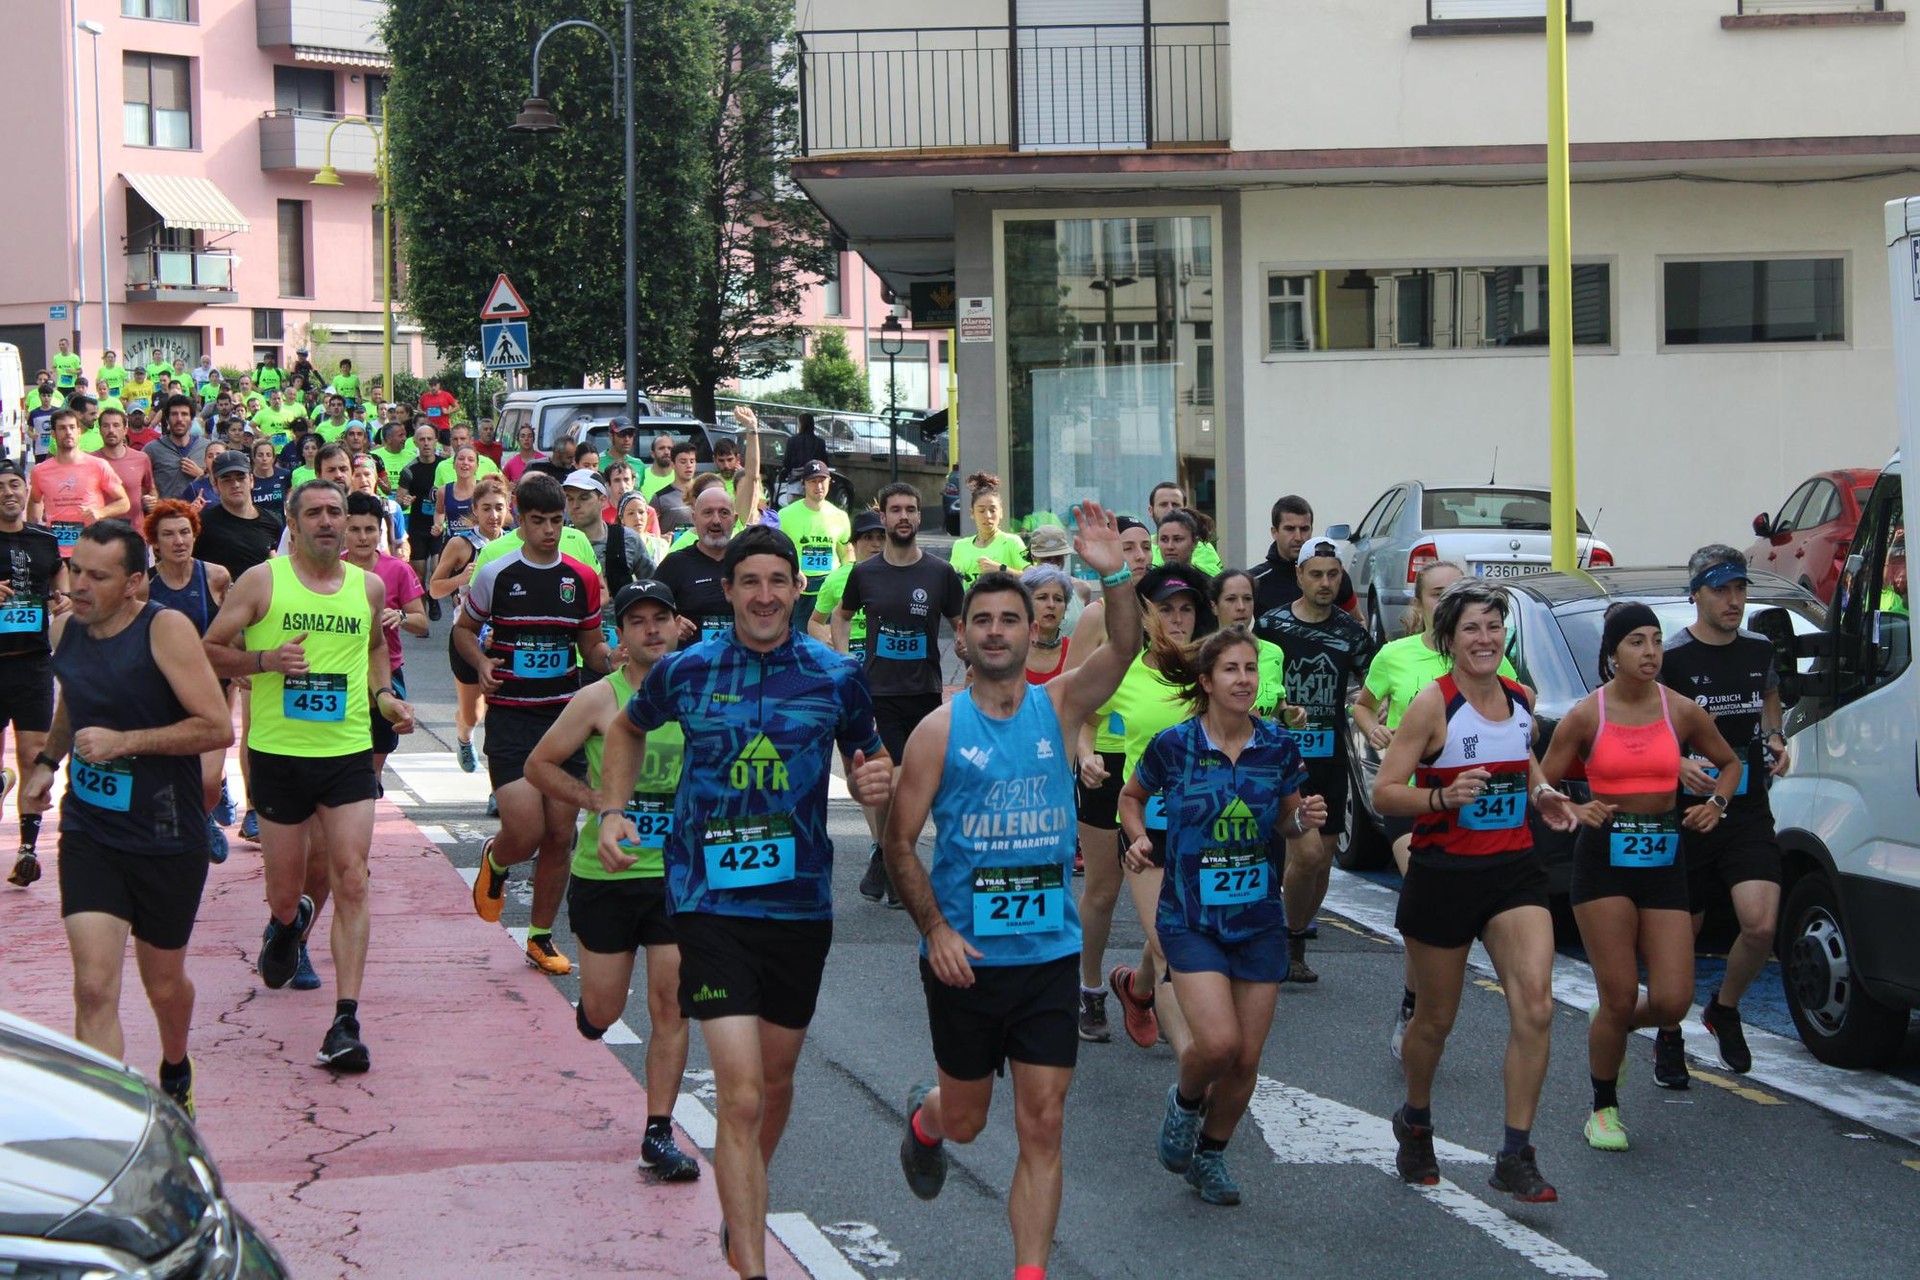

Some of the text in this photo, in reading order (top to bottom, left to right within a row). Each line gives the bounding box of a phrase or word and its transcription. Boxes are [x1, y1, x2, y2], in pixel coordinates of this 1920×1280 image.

[56, 531, 79, 540] 229
[807, 556, 828, 566] 218
[4, 610, 36, 624] 425
[886, 638, 918, 652] 388
[524, 653, 560, 668] 320
[294, 694, 338, 712] 453
[1708, 694, 1741, 704] ZURICH
[76, 768, 118, 796] 426
[730, 760, 790, 790] OTR
[984, 775, 1048, 811] 42K
[1473, 796, 1516, 818] 341
[712, 830, 734, 838] TRAIL
[974, 842, 988, 852] WE
[991, 841, 1010, 850] ARE
[1623, 836, 1668, 855] 234
[719, 843, 781, 872] 423
[1214, 868, 1260, 892] 272
[990, 893, 1046, 920] 271
